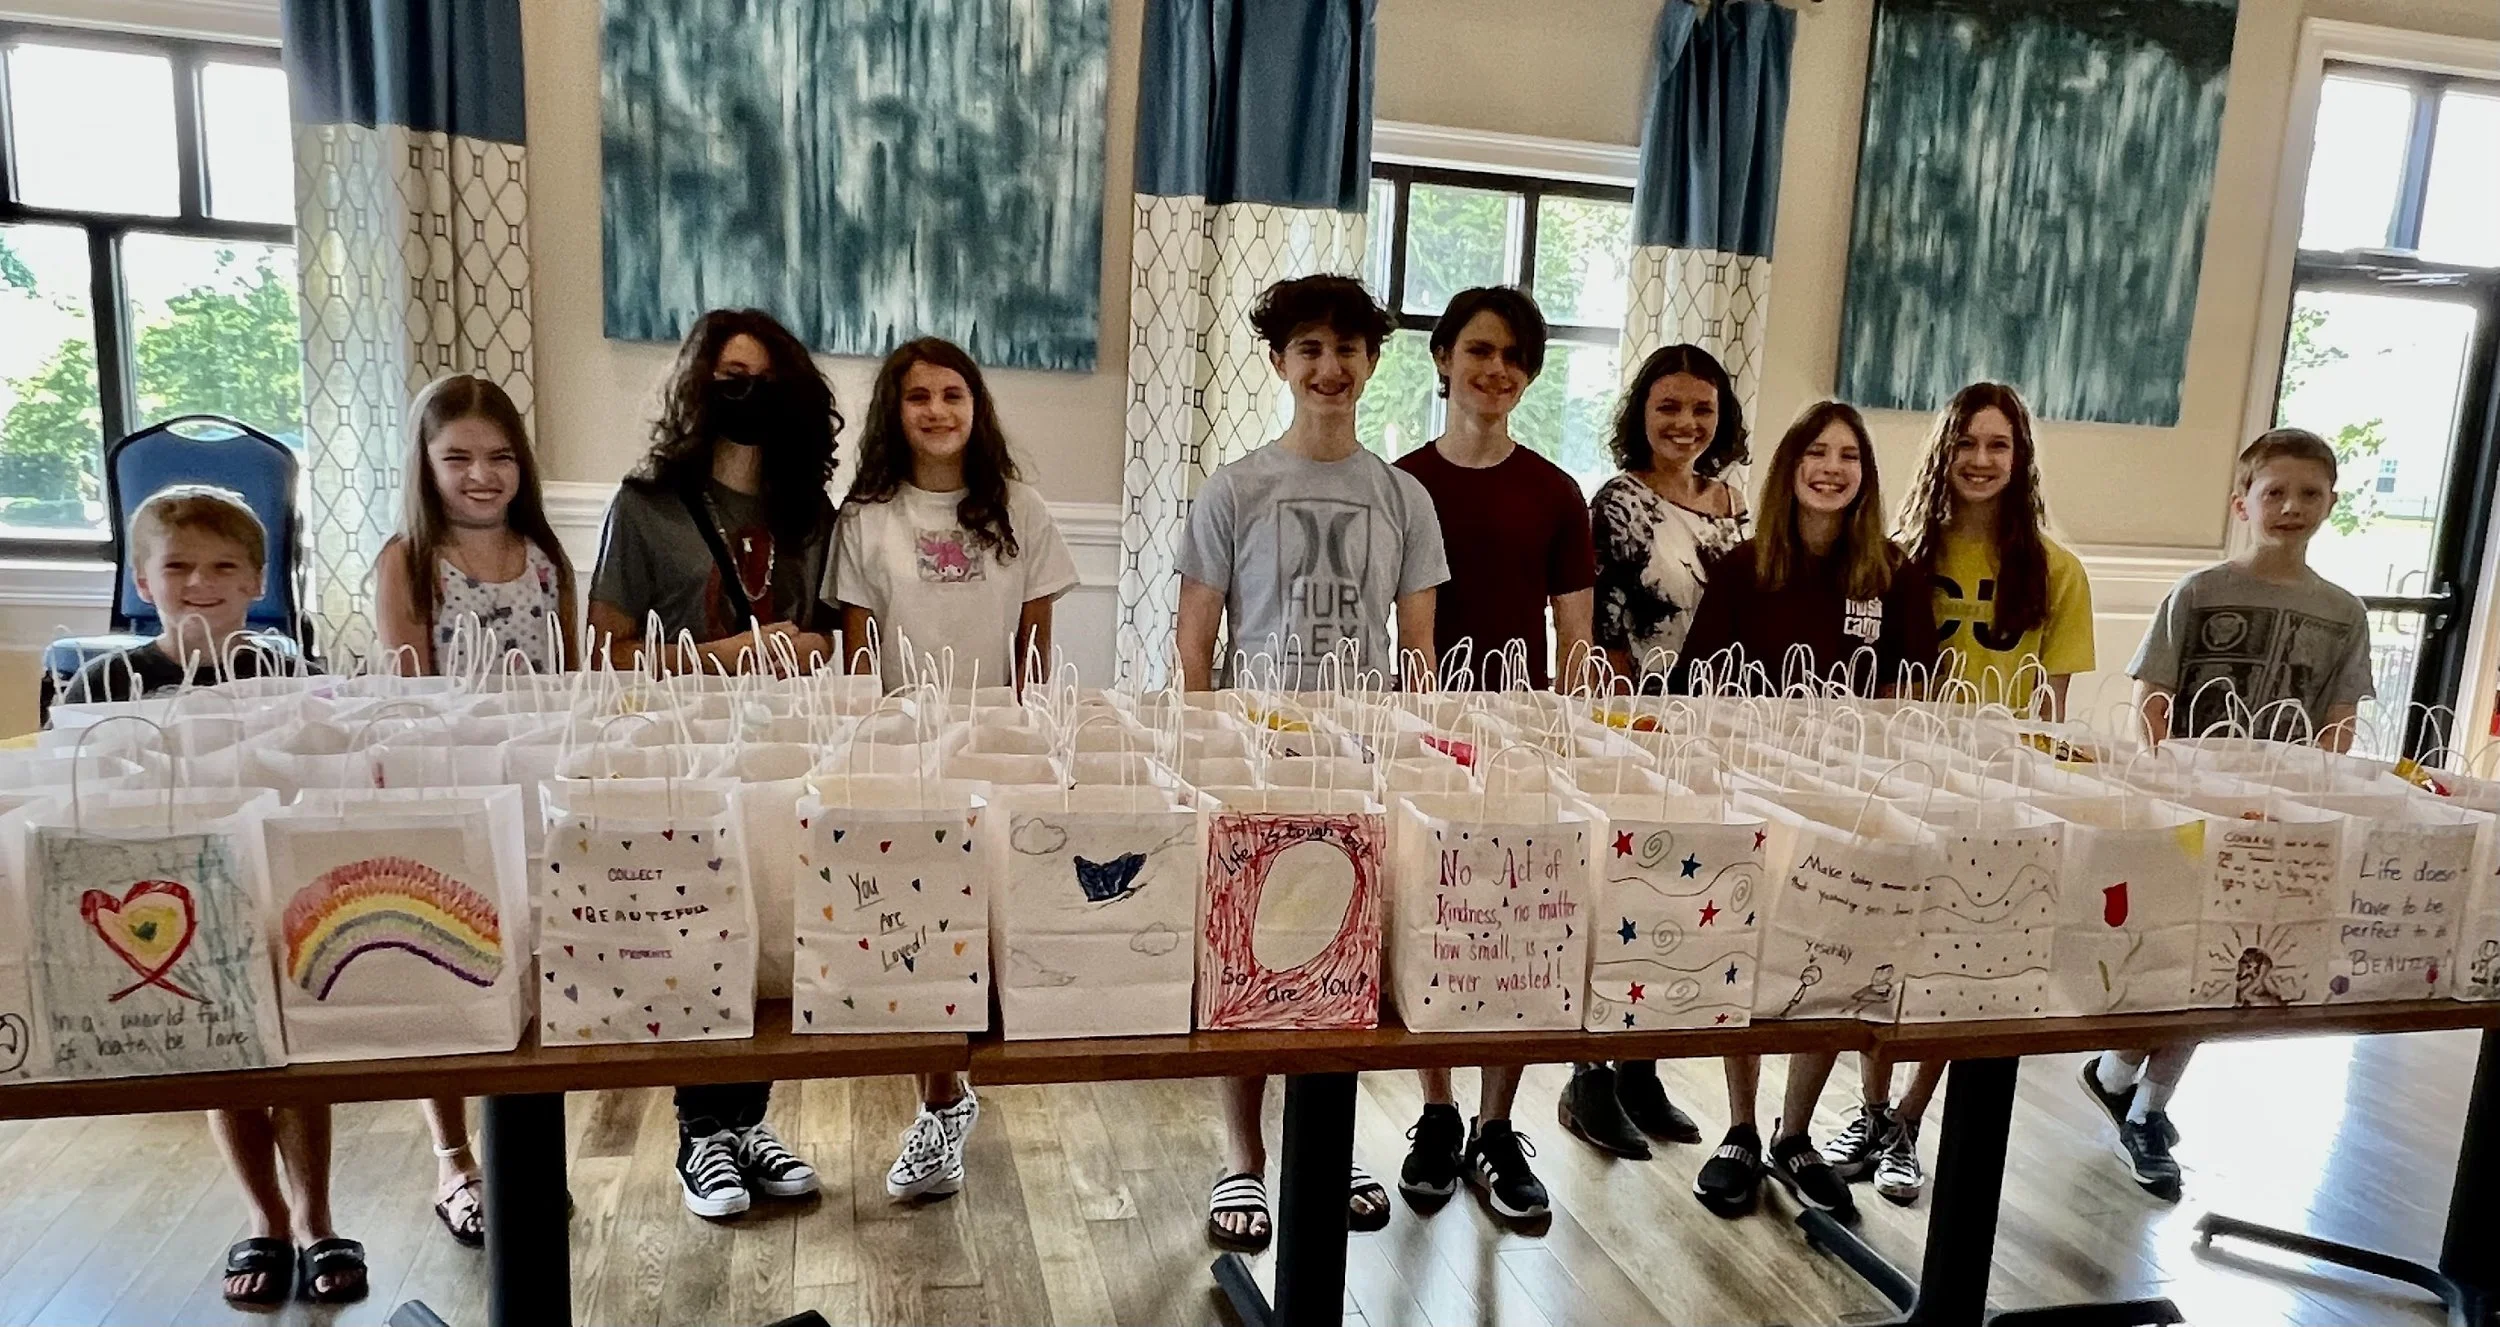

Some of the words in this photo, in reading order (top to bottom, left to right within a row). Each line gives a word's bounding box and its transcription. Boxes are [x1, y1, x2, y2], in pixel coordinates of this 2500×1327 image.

[1288, 582, 1359, 619] HUR
[1218, 841, 1251, 876] Life
[1285, 822, 1334, 841] tough
[607, 868, 664, 882] COLLECT
[1439, 850, 1472, 887] No
[1492, 847, 1532, 889] Act
[1545, 849, 1563, 882] of
[1799, 855, 1843, 879] Make
[2360, 852, 2402, 881] Life
[848, 872, 880, 905] You
[2350, 889, 2390, 916] have
[2402, 896, 2417, 916] to
[2424, 897, 2443, 914] be
[1514, 904, 1530, 922] no
[1538, 890, 1578, 920] matter
[880, 911, 905, 933] Are
[2340, 921, 2401, 945] perfect
[881, 925, 927, 973] Loved!
[1433, 932, 1461, 960] how
[1469, 933, 1516, 963] small,
[1526, 941, 1536, 957] is
[1222, 965, 1249, 986] So
[1320, 971, 1369, 998] You!
[1449, 974, 1481, 993] ever
[1496, 957, 1562, 992] wasted!
[120, 1004, 185, 1030] world
[165, 1028, 186, 1051] be
[205, 1024, 249, 1049] love
